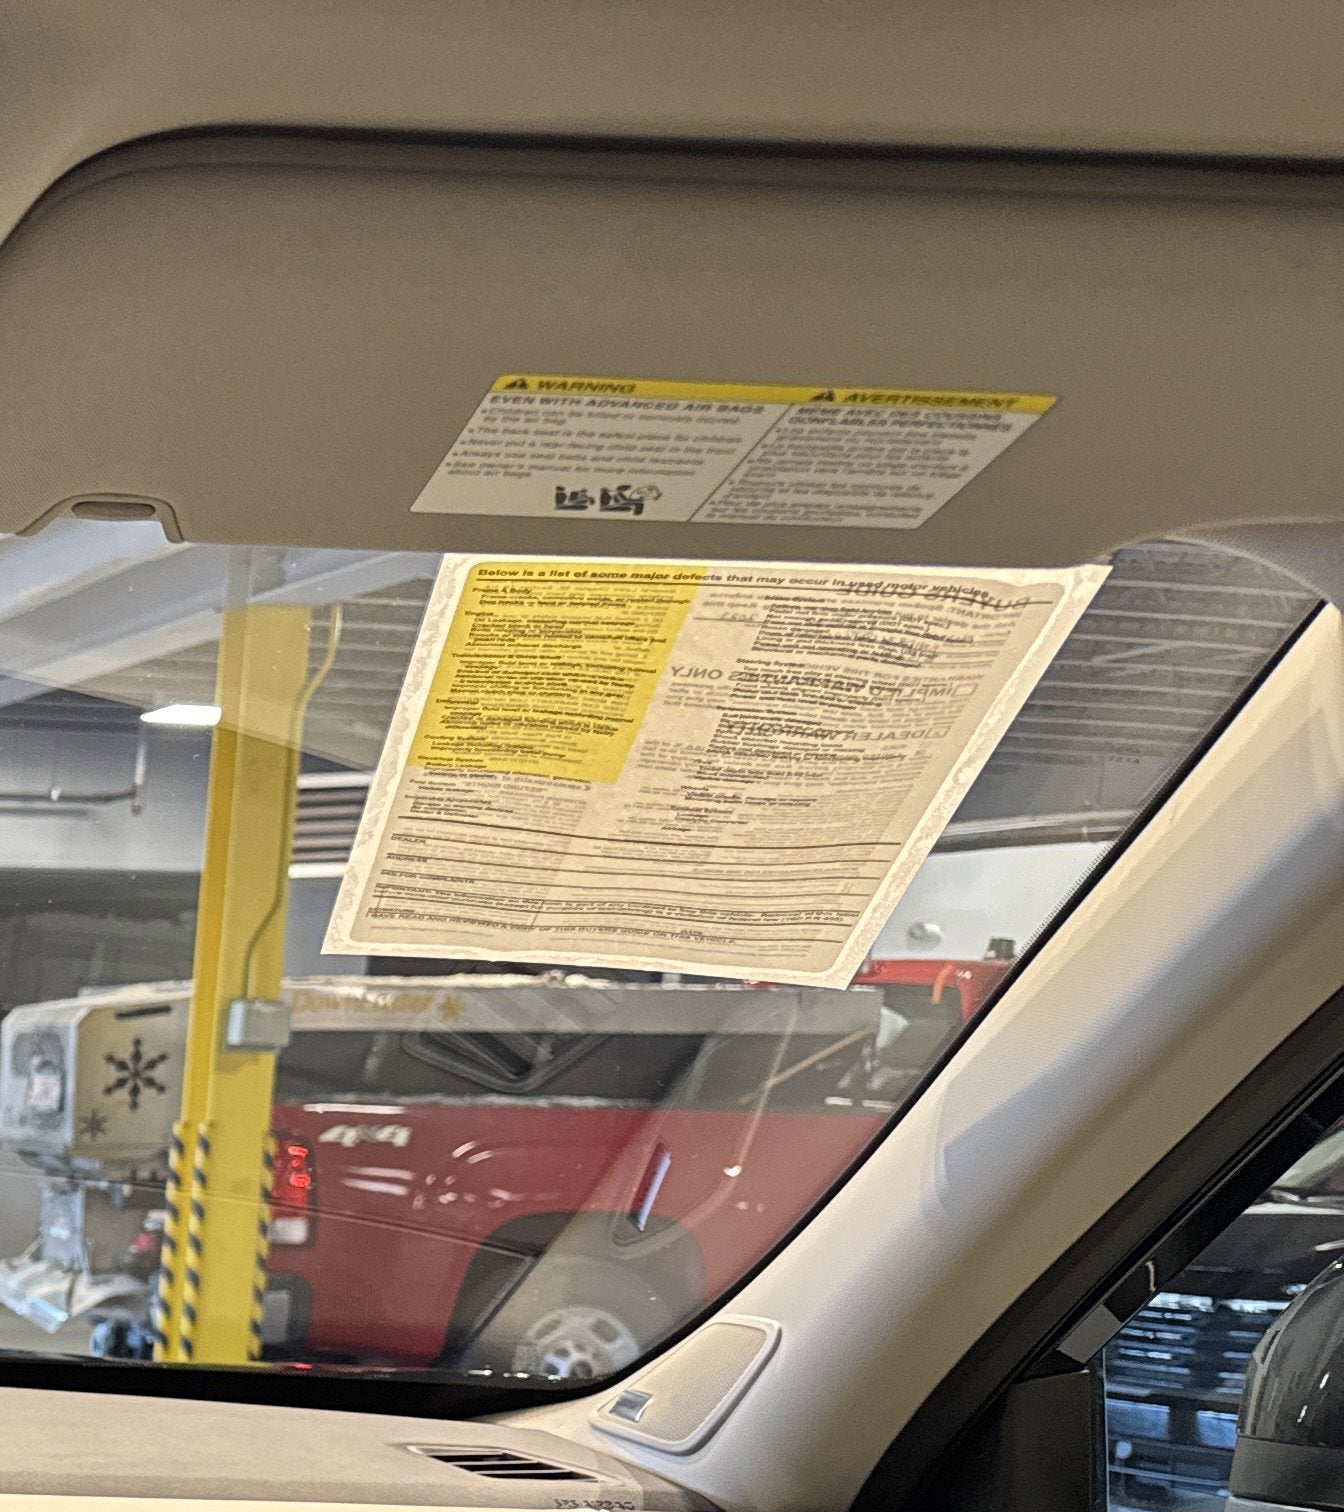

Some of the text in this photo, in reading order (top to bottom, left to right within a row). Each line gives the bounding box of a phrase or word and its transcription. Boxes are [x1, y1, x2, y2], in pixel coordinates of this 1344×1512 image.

[536, 380, 637, 394] WARNING
[539, 395, 582, 407] WITH
[585, 399, 679, 412] ADVANCED
[716, 405, 764, 415] BAGS
[844, 391, 1019, 409] AVERTISSEMENT
[478, 569, 519, 578] Below
[631, 572, 669, 581] major
[673, 573, 722, 582] defects
